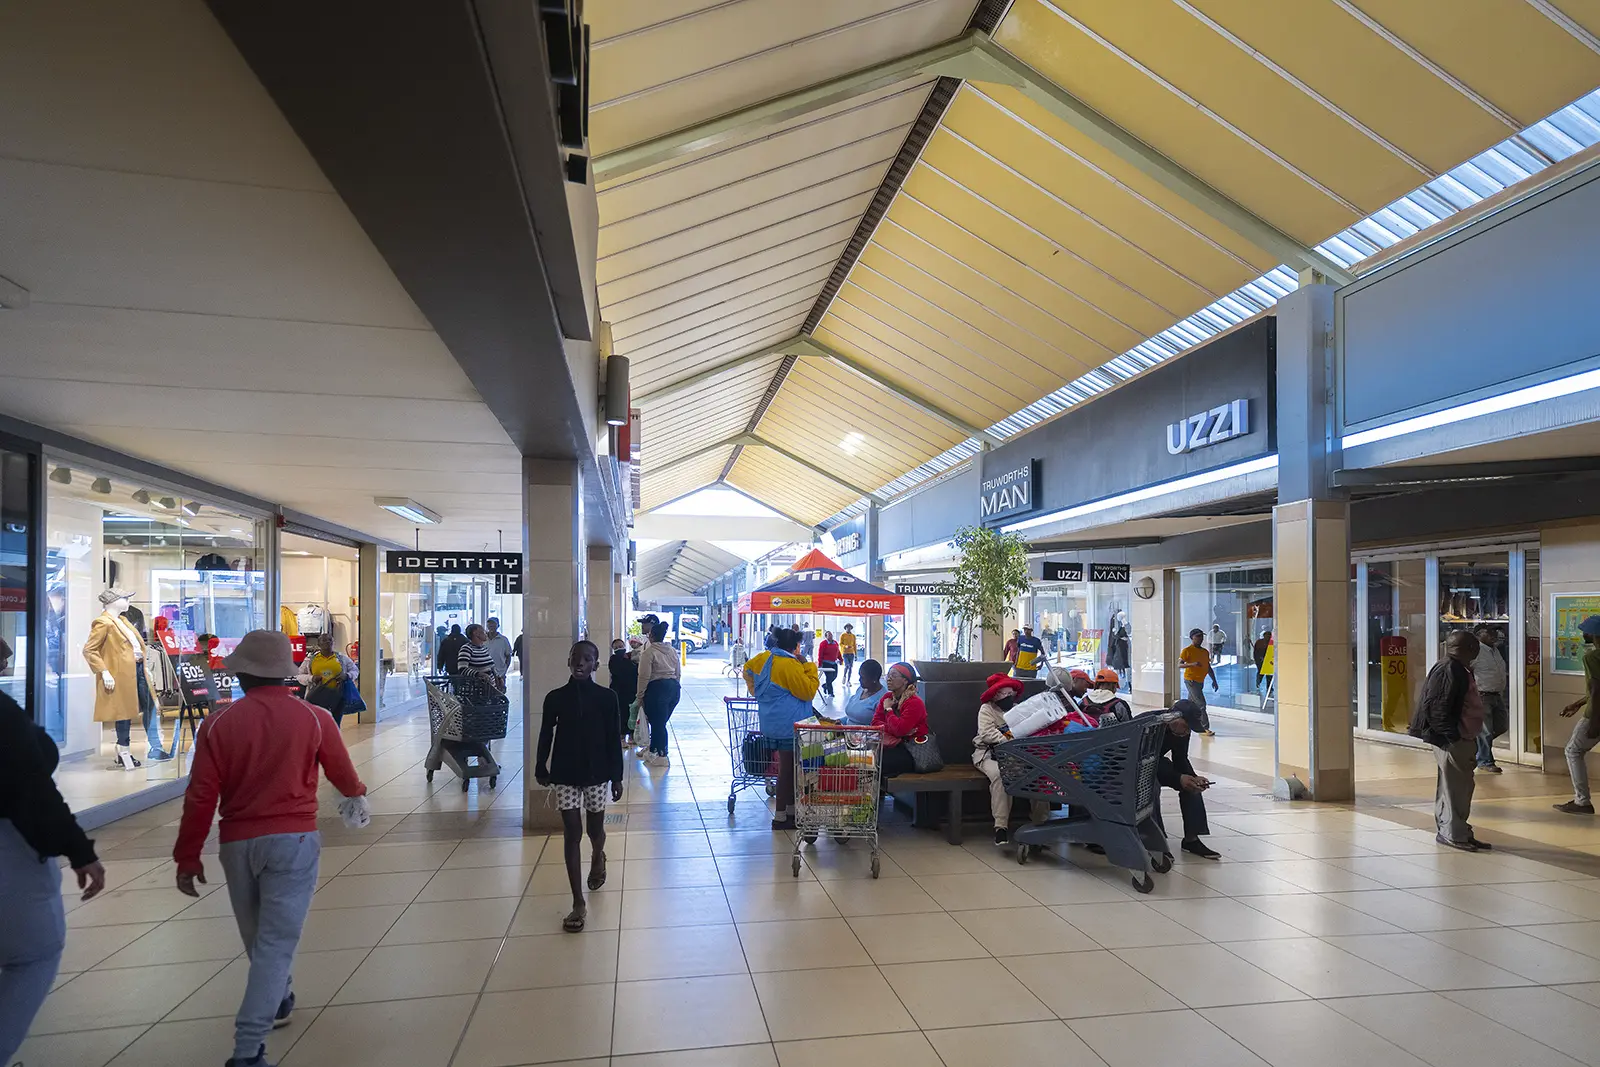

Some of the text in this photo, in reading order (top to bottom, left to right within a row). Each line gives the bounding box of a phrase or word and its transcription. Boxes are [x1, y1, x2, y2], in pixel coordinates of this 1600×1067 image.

[1167, 399, 1246, 455] UZZI
[982, 465, 1029, 492] TRUWORTHS
[981, 481, 1028, 518] MAN
[794, 570, 855, 583] Tiro
[1057, 570, 1081, 580] UZZI
[1093, 571, 1127, 581] MAN
[834, 598, 891, 610] WELCOME
[290, 643, 304, 652] LE
